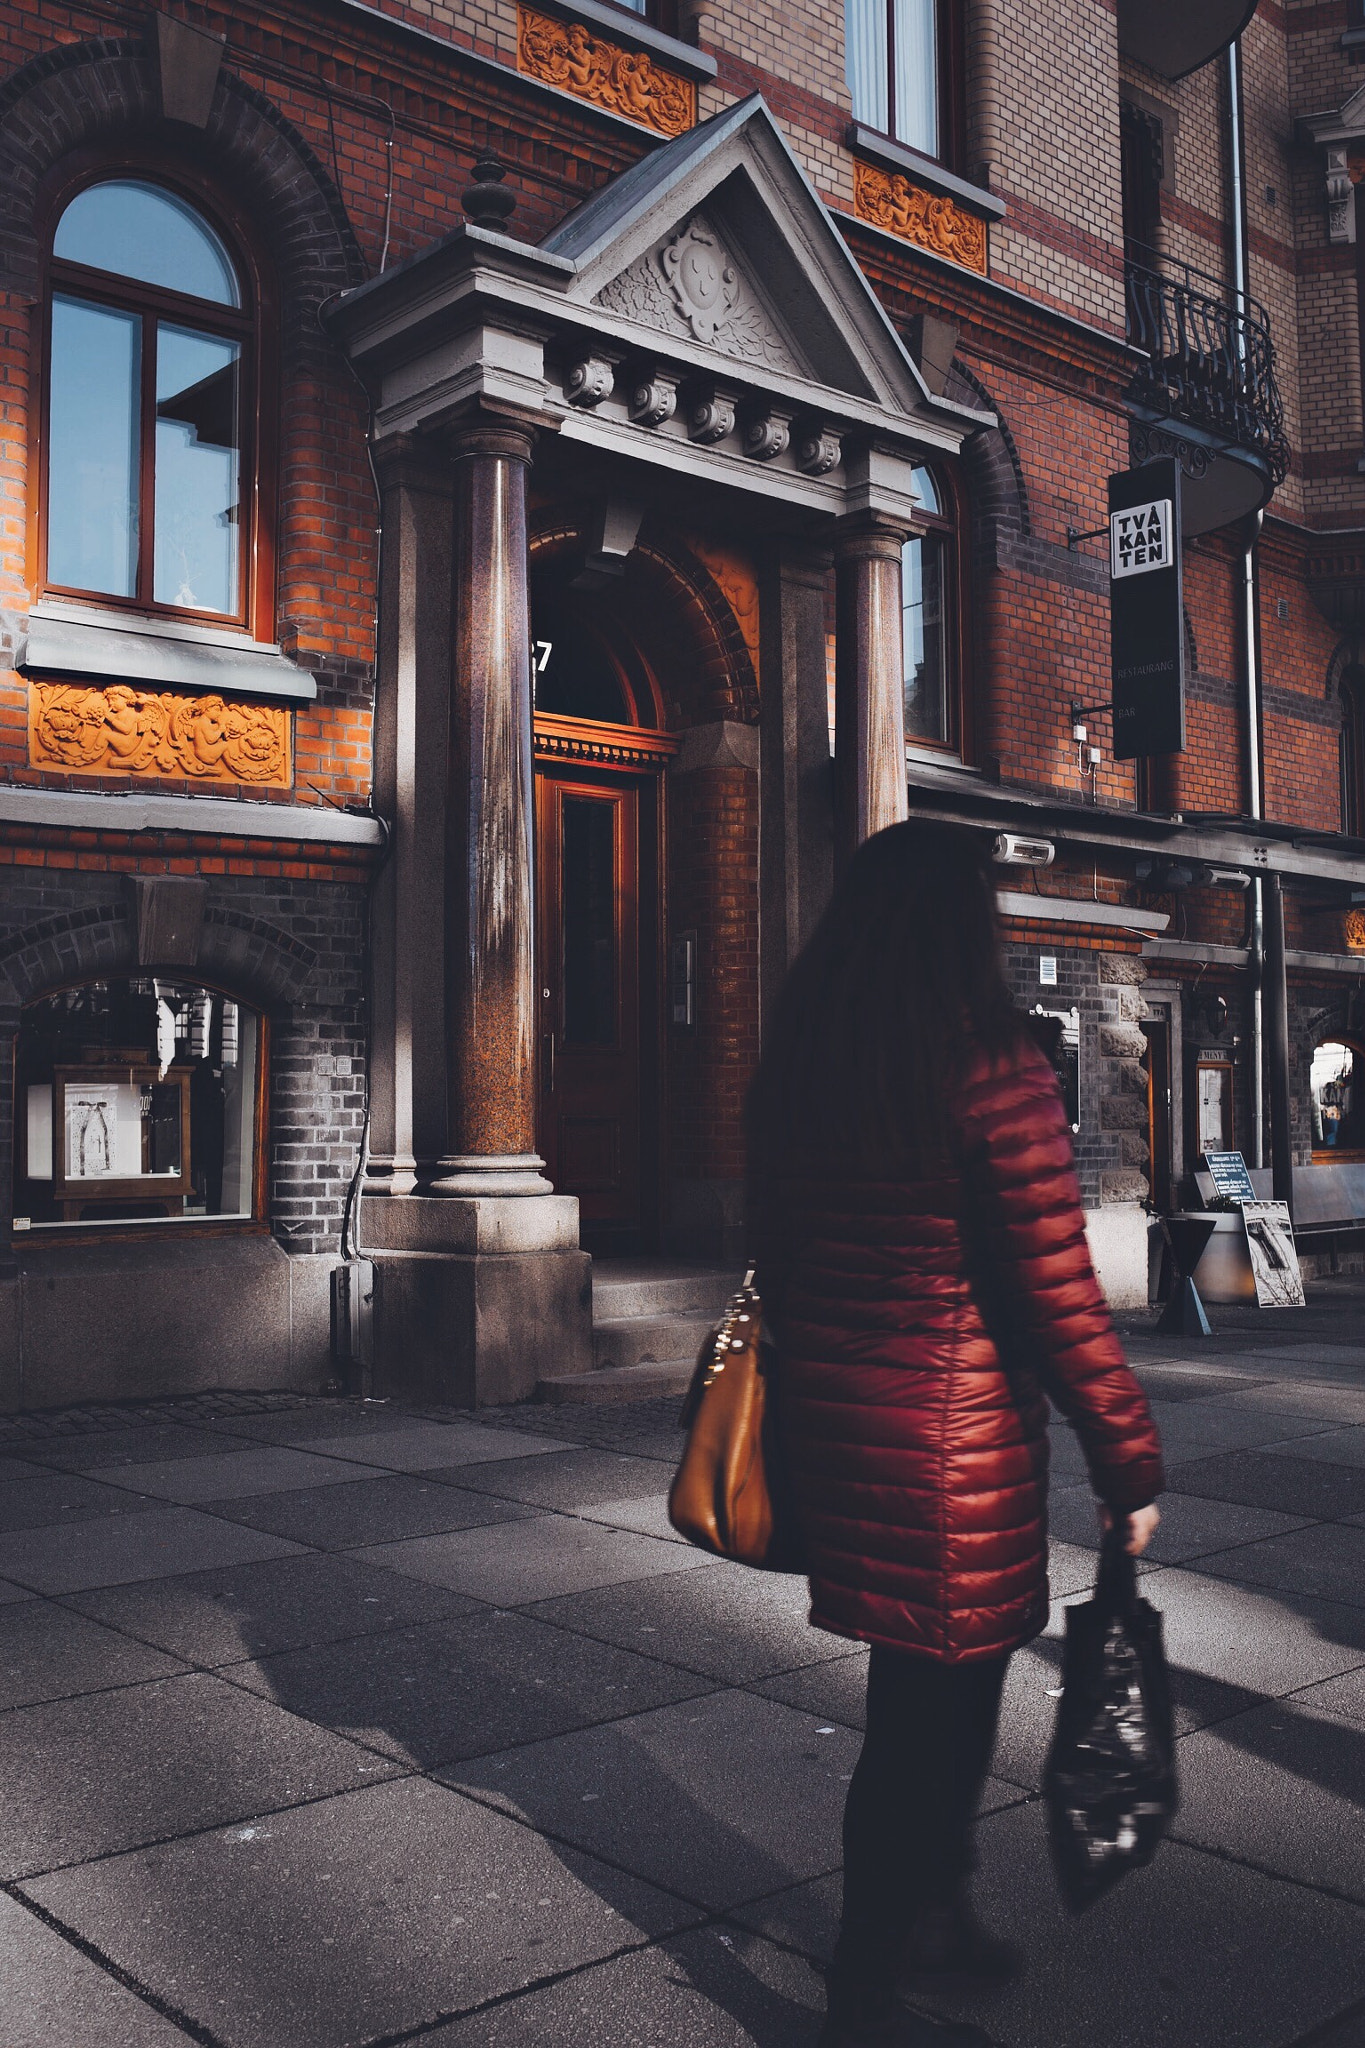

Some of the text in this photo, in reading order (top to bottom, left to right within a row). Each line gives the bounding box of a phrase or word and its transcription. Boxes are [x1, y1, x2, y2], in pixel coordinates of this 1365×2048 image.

[1118, 505, 1160, 533] TVÅ
[1119, 527, 1161, 552] KAN
[1119, 544, 1162, 568] TEN
[532, 641, 552, 672] 7
[1117, 659, 1174, 679] RESTAURANG
[1118, 706, 1136, 719] BAR
